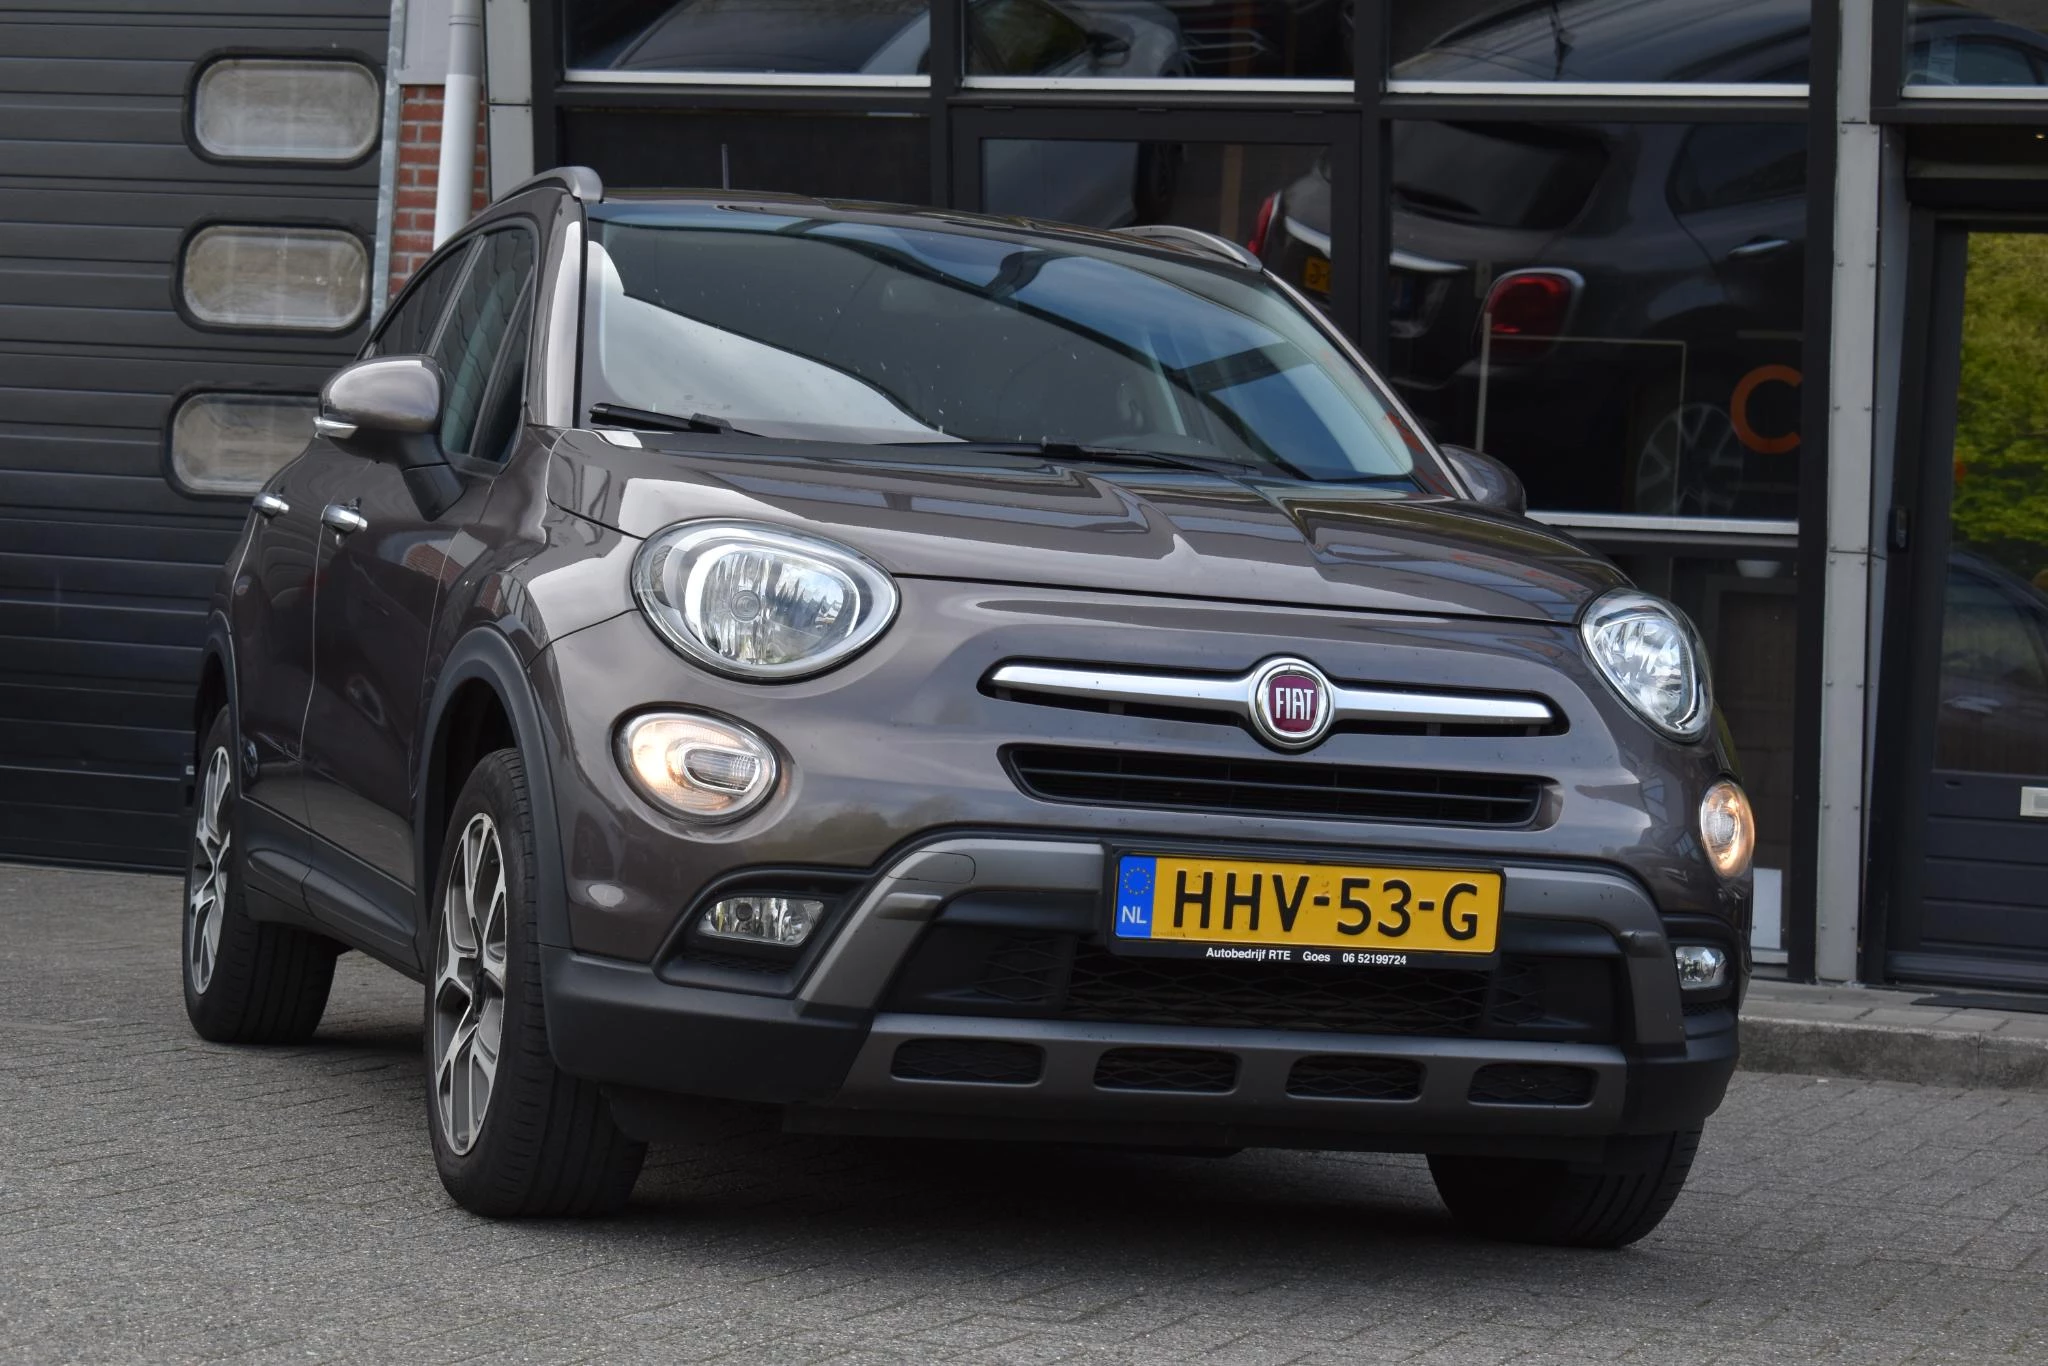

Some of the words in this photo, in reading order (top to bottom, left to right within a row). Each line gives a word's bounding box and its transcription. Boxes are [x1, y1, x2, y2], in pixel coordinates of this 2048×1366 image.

[1275, 687, 1315, 721] FIAT
[1121, 905, 1148, 924] NL
[1173, 869, 1478, 941] HHV-53-G
[1206, 947, 1266, 962] Autobedrijf
[1268, 950, 1292, 961] RTE
[1302, 950, 1331, 962] Goes
[1342, 952, 1355, 963] 06
[1357, 953, 1407, 965] 52199724
